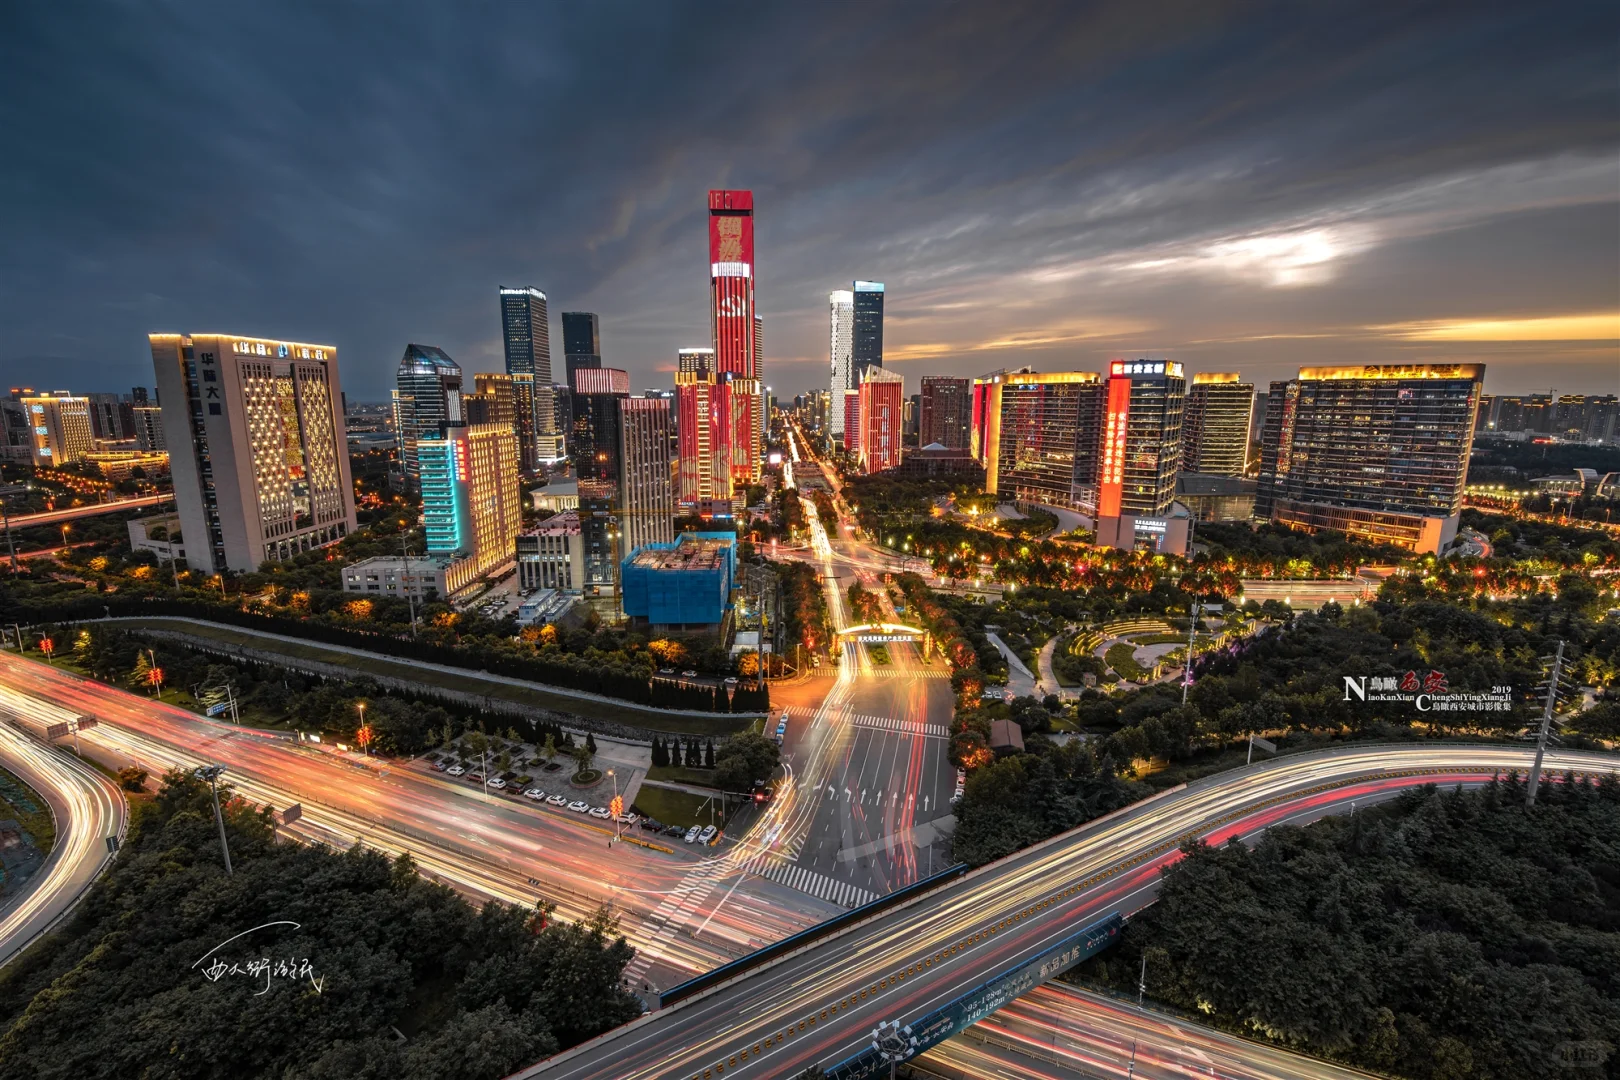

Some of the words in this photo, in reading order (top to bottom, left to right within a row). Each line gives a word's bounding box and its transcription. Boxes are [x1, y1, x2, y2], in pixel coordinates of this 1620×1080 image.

[200, 352, 222, 416] 华陆大
[1123, 363, 1165, 374] 西安高新
